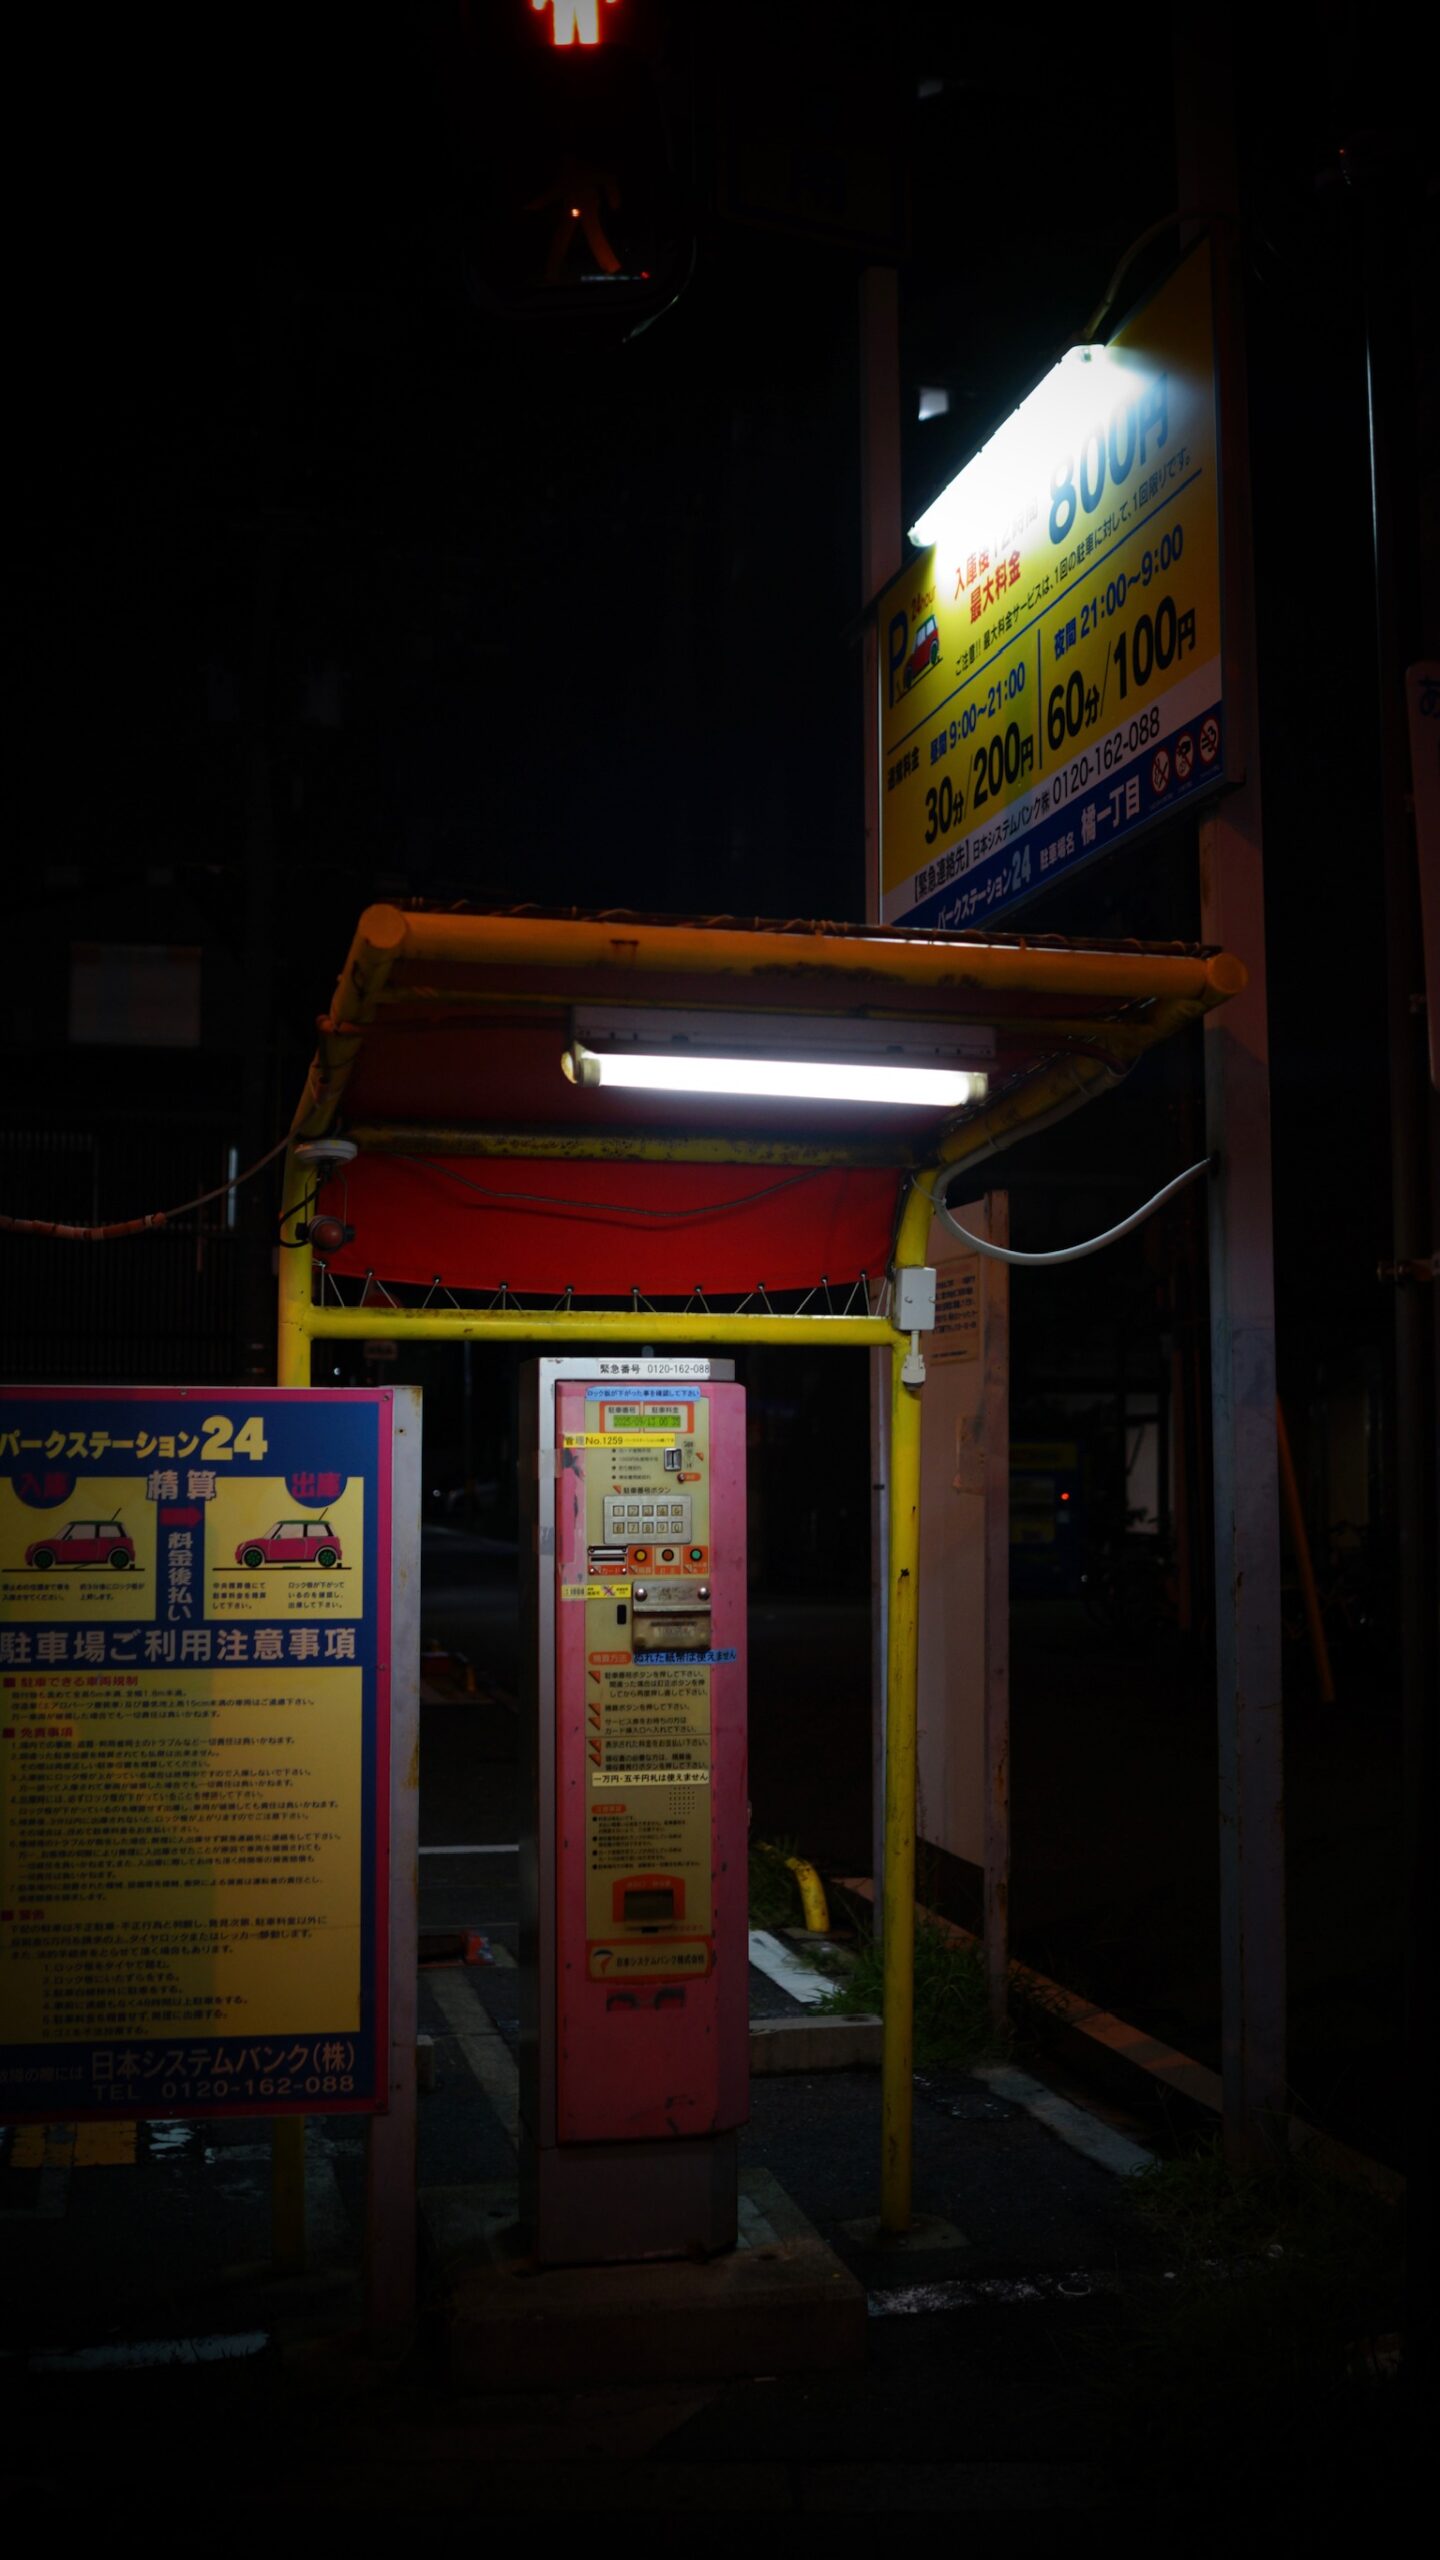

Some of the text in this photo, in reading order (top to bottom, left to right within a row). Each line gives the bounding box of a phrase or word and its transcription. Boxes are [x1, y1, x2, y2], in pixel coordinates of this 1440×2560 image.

[969, 549, 1022, 624] 最大料金
[889, 609, 909, 707] P
[1053, 619, 1077, 661] 夜間
[1052, 706, 1160, 803] 0120-162-088
[600, 1363, 711, 1375] 緊急番号 0120-162-088
[0, 1414, 268, 1462] パークステーション24
[146, 1469, 217, 1501] 精算
[166, 1531, 193, 1622] 料金後払い
[0, 1628, 357, 1664] 駐車場ご利用注意事項
[93, 2074, 356, 2102] TEL 0120-162-088
